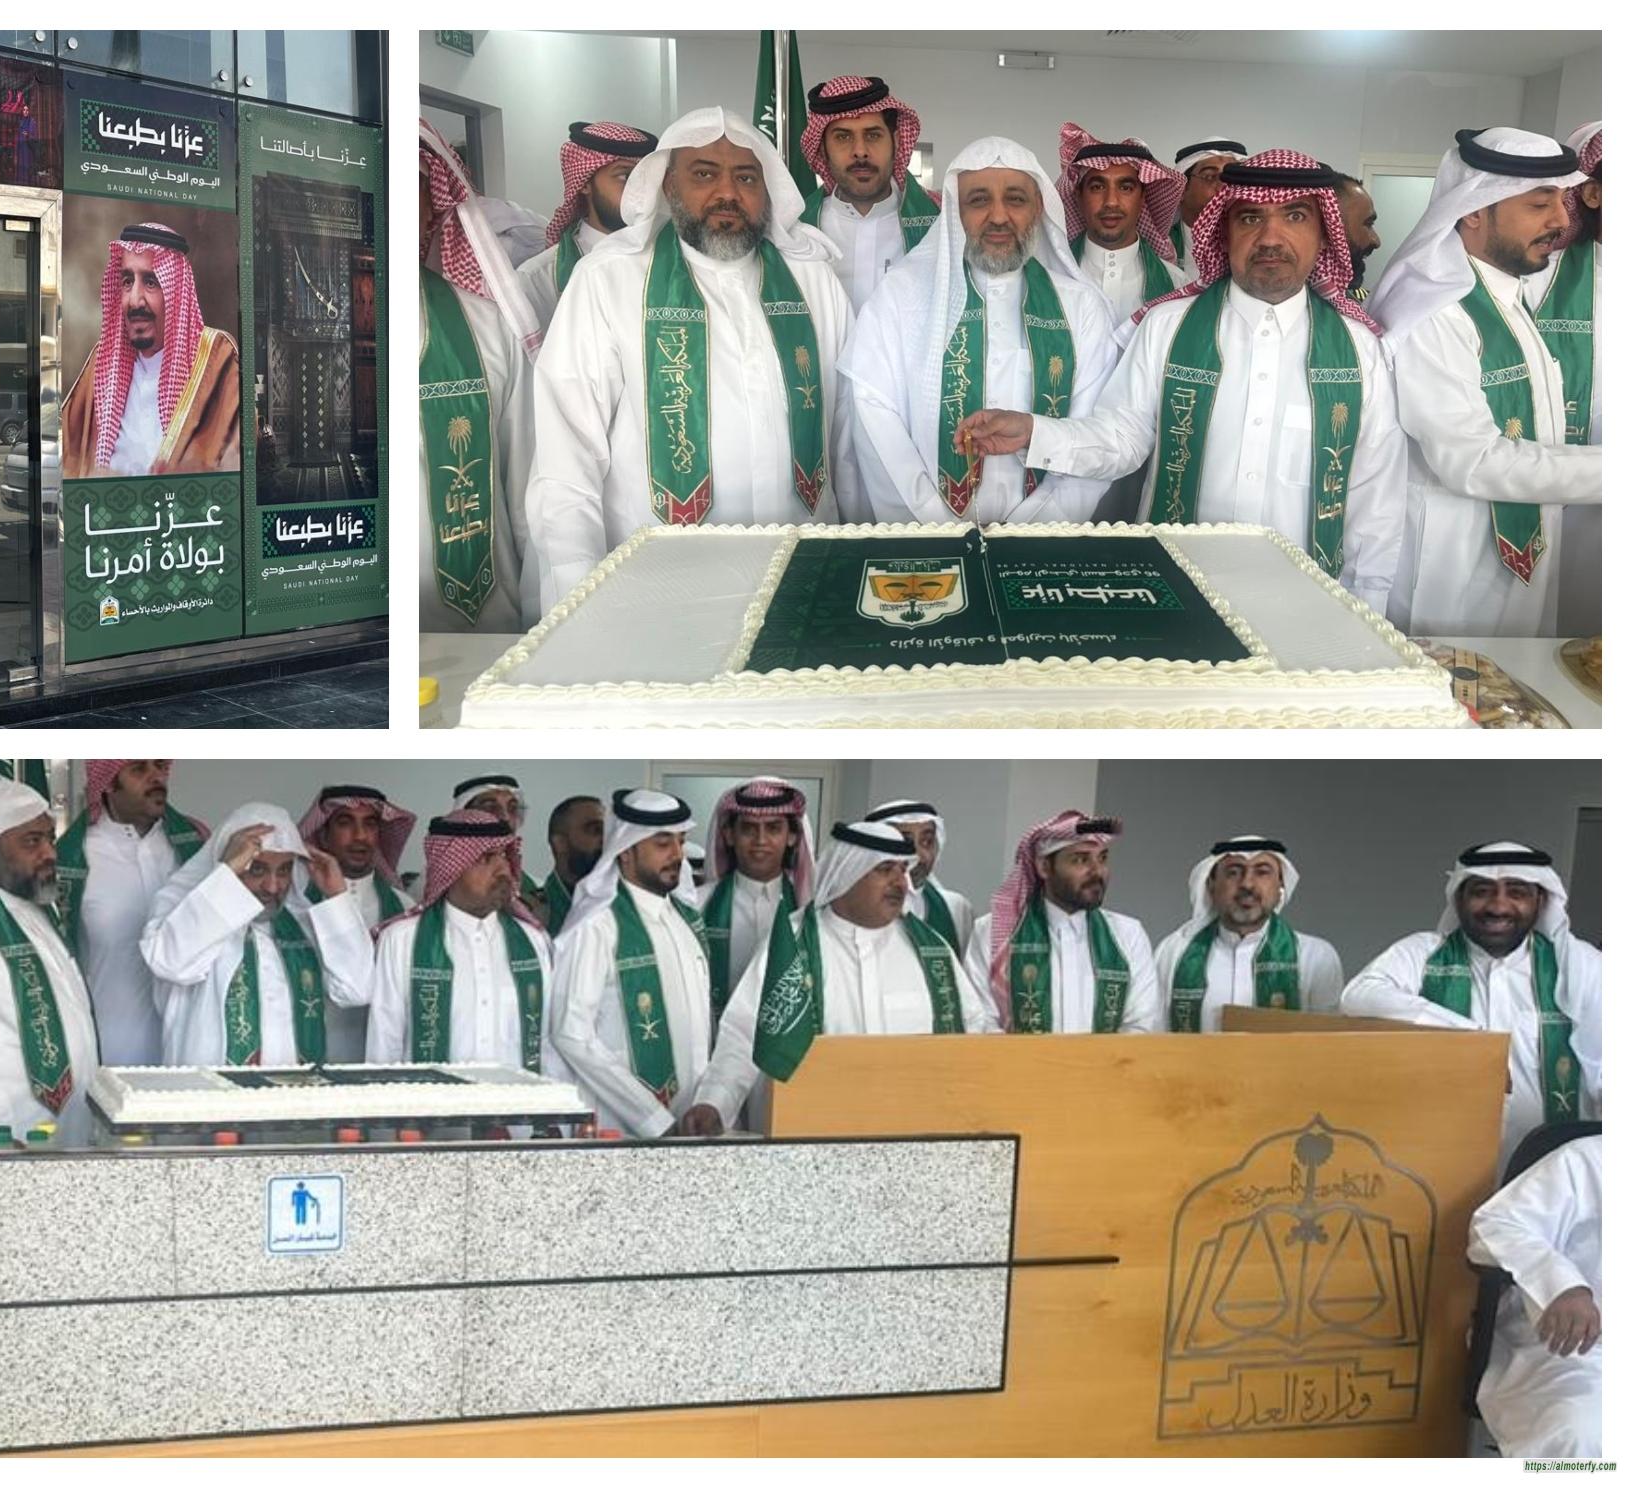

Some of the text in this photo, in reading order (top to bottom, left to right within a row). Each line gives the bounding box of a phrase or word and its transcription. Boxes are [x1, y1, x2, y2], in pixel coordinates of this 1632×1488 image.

[98, 111, 166, 155] بطبعنا
[260, 135, 315, 162] بأصالتنا
[80, 160, 220, 189] اليوم الوطني السعودي
[106, 183, 198, 200] SAUDI NATIONAL DAY
[275, 514, 332, 549] بطبعنا
[84, 535, 225, 584] بولاة أمرنا
[260, 553, 378, 580] اليوم الوطني السعودي
[283, 575, 359, 590] SAUDI NATIONAL DAY
[1065, 582, 1158, 605] بطبعنا
[890, 637, 925, 649] دائرة
[928, 636, 984, 650] الأوقاف
[987, 634, 997, 643] و
[1058, 633, 1117, 646] بالأحساء
[1205, 1365, 1372, 1431] وزارة العدل
